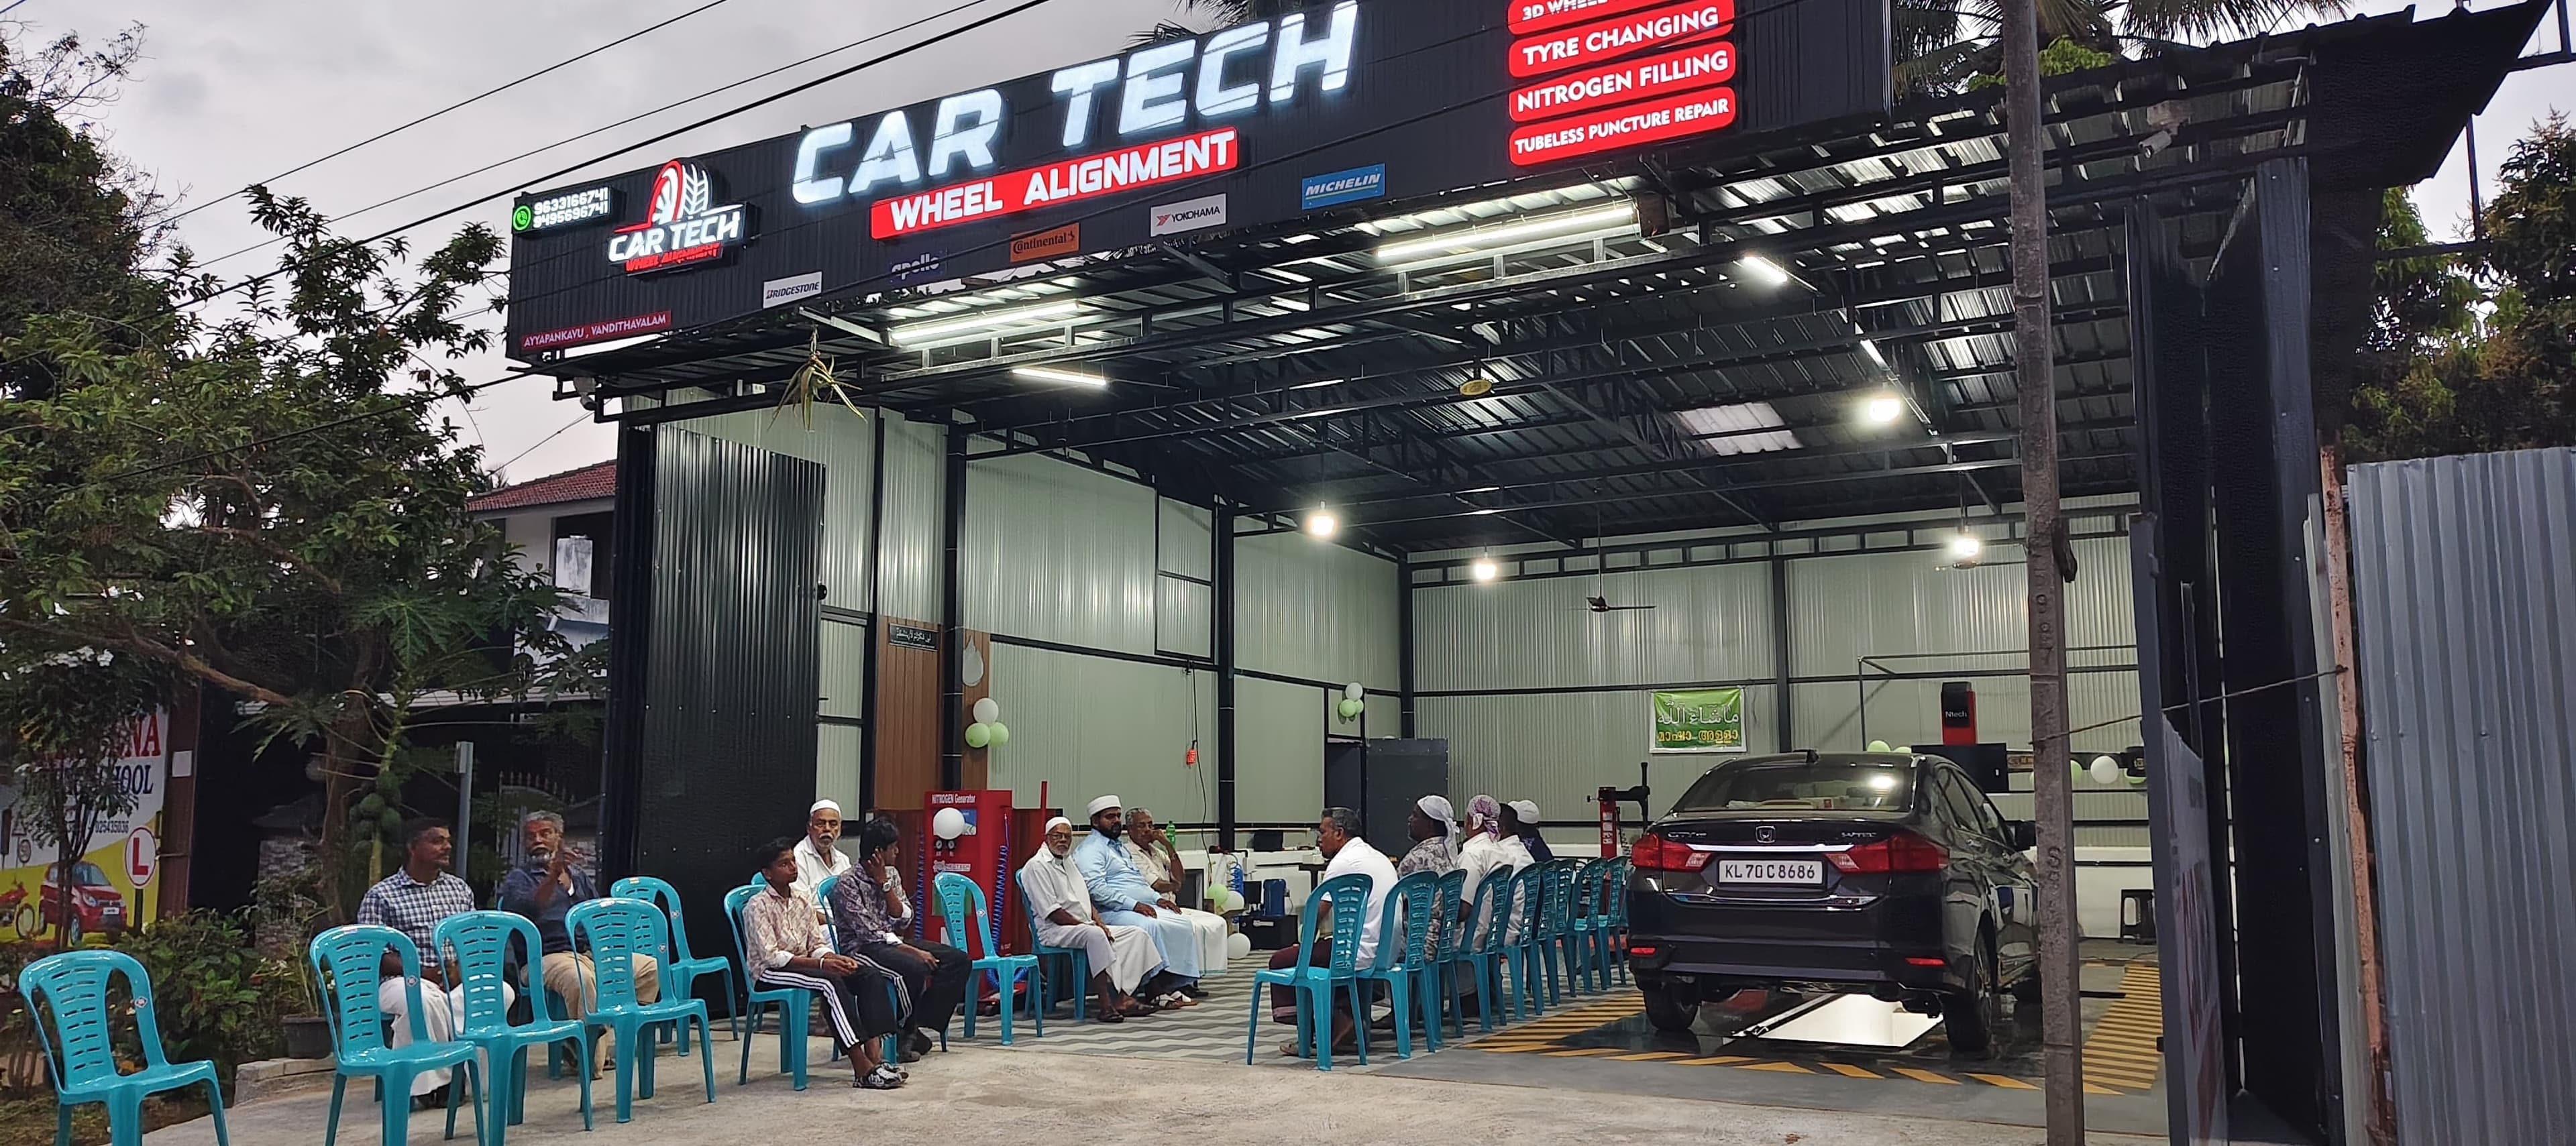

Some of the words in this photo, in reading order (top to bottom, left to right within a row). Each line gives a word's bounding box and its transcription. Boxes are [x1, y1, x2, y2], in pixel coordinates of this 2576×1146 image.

[1522, 4, 1544, 21] 3D
[1546, 0, 1608, 15] WHE
[1523, 38, 1579, 66] TYRE
[1585, 7, 1719, 52] CHANGING
[1517, 70, 1632, 113] NITROGEN
[1640, 51, 1728, 87] FILLING
[791, 88, 1002, 205] CAR
[1051, 1, 1360, 148] TECH
[1515, 127, 1585, 154] TUBELESS
[1589, 109, 1670, 140] PUNCTURE
[1674, 99, 1729, 123] REPAIR
[890, 181, 1004, 231] WHEEL
[1023, 130, 1236, 205] ALIGNMENT
[1305, 174, 1381, 196] MICHELIN
[533, 200, 608, 228] 9495696741
[534, 187, 608, 215] 9633166741
[1171, 206, 1220, 223] YOKOHAMA
[608, 228, 665, 262] CAR
[669, 211, 741, 250] TECH
[1013, 235, 1067, 254] Continental
[626, 255, 659, 271] WHEEL
[892, 253, 940, 280] apollo
[766, 282, 820, 299] BRIDGESTONE
[524, 328, 584, 347] AYYAPANKAVU
[591, 314, 666, 335] VANDITHAVALAM
[932, 793, 954, 804] NITROGEN
[133, 837, 148, 876] L
[1725, 865, 1743, 878] KL
[1746, 865, 1763, 878] 70
[1767, 865, 1775, 878] C
[1778, 864, 1815, 879] 8686
